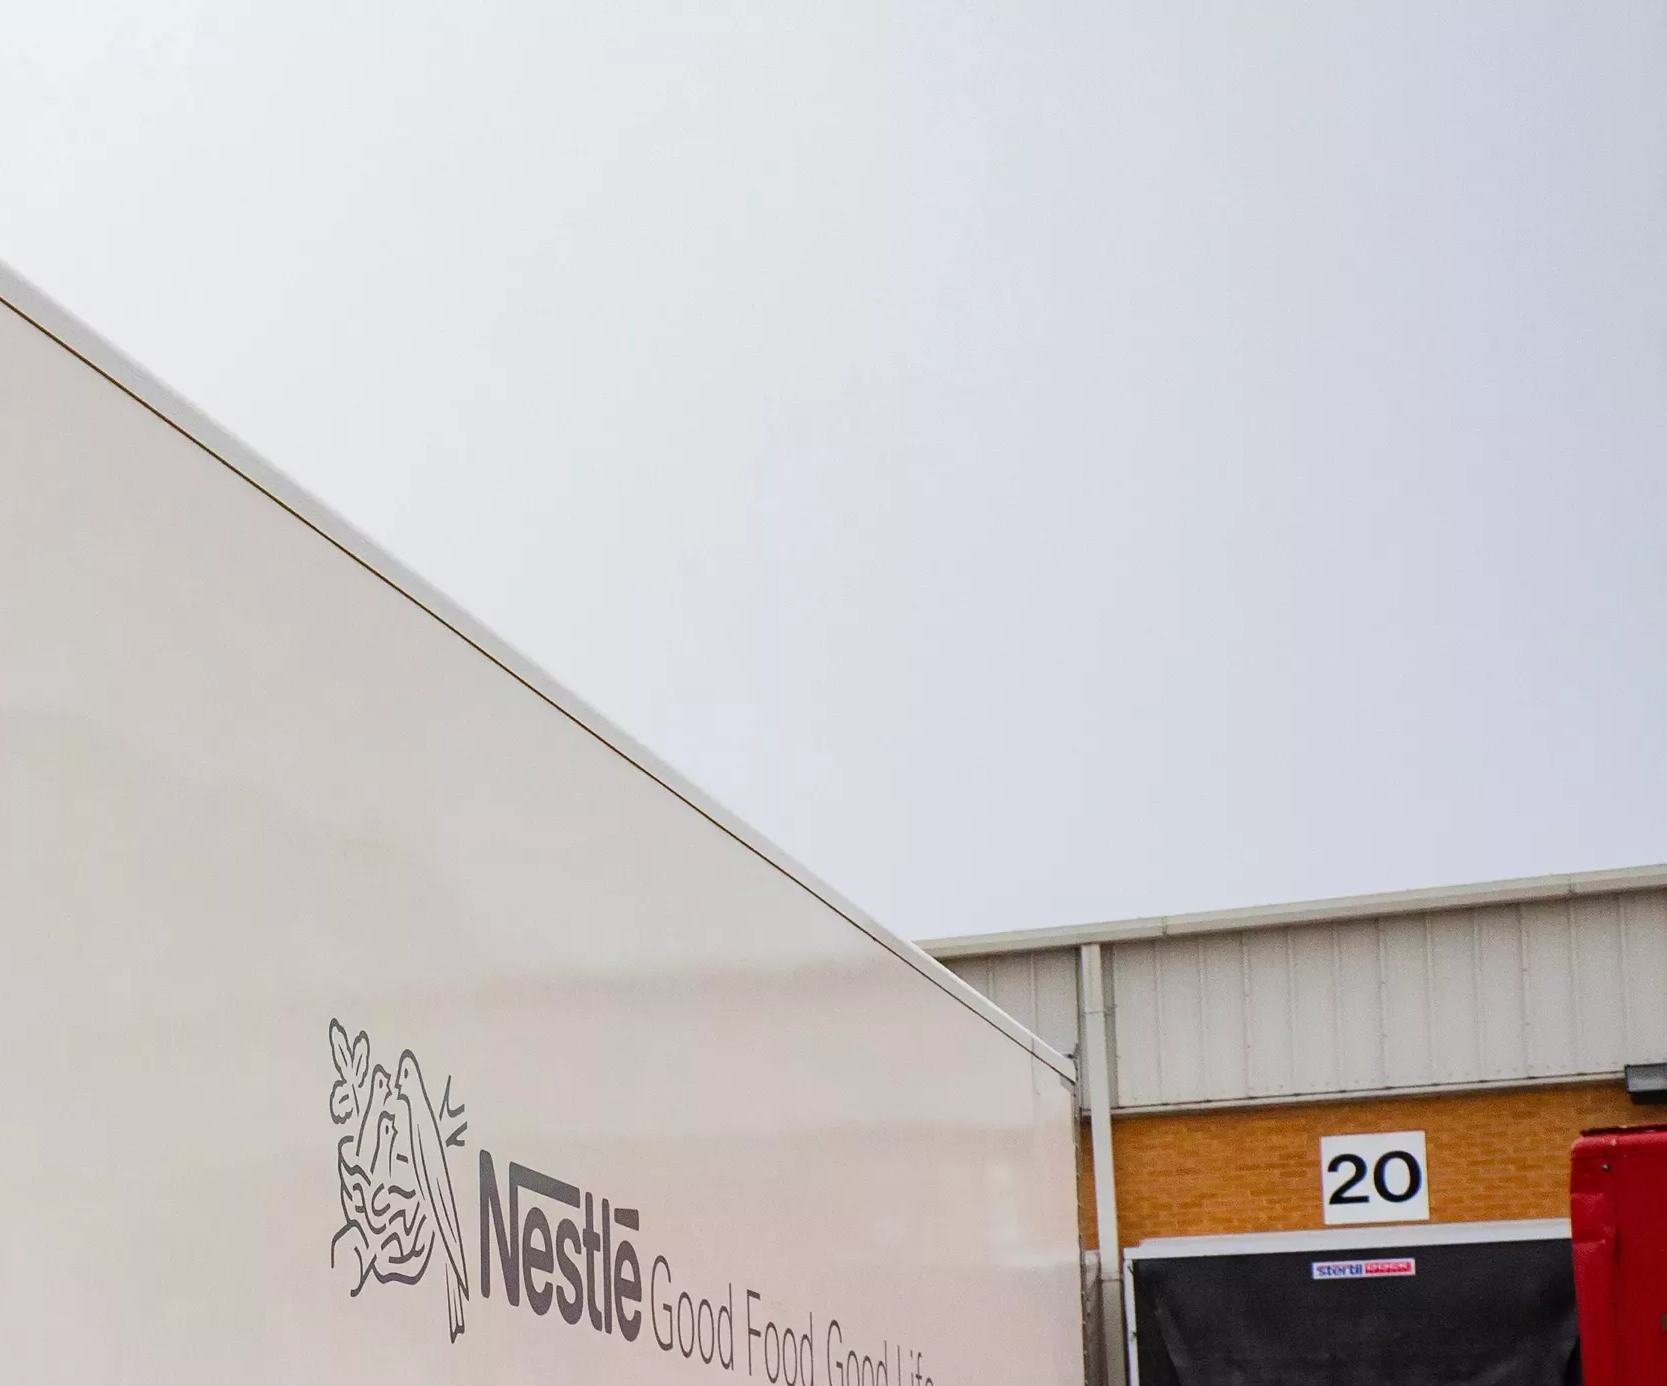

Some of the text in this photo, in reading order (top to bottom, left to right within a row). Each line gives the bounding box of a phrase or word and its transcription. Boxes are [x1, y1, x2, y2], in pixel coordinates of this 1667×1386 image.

[1326, 1150, 1423, 1206] 20
[479, 1149, 643, 1343] Nestlé
[650, 1255, 735, 1371] Good
